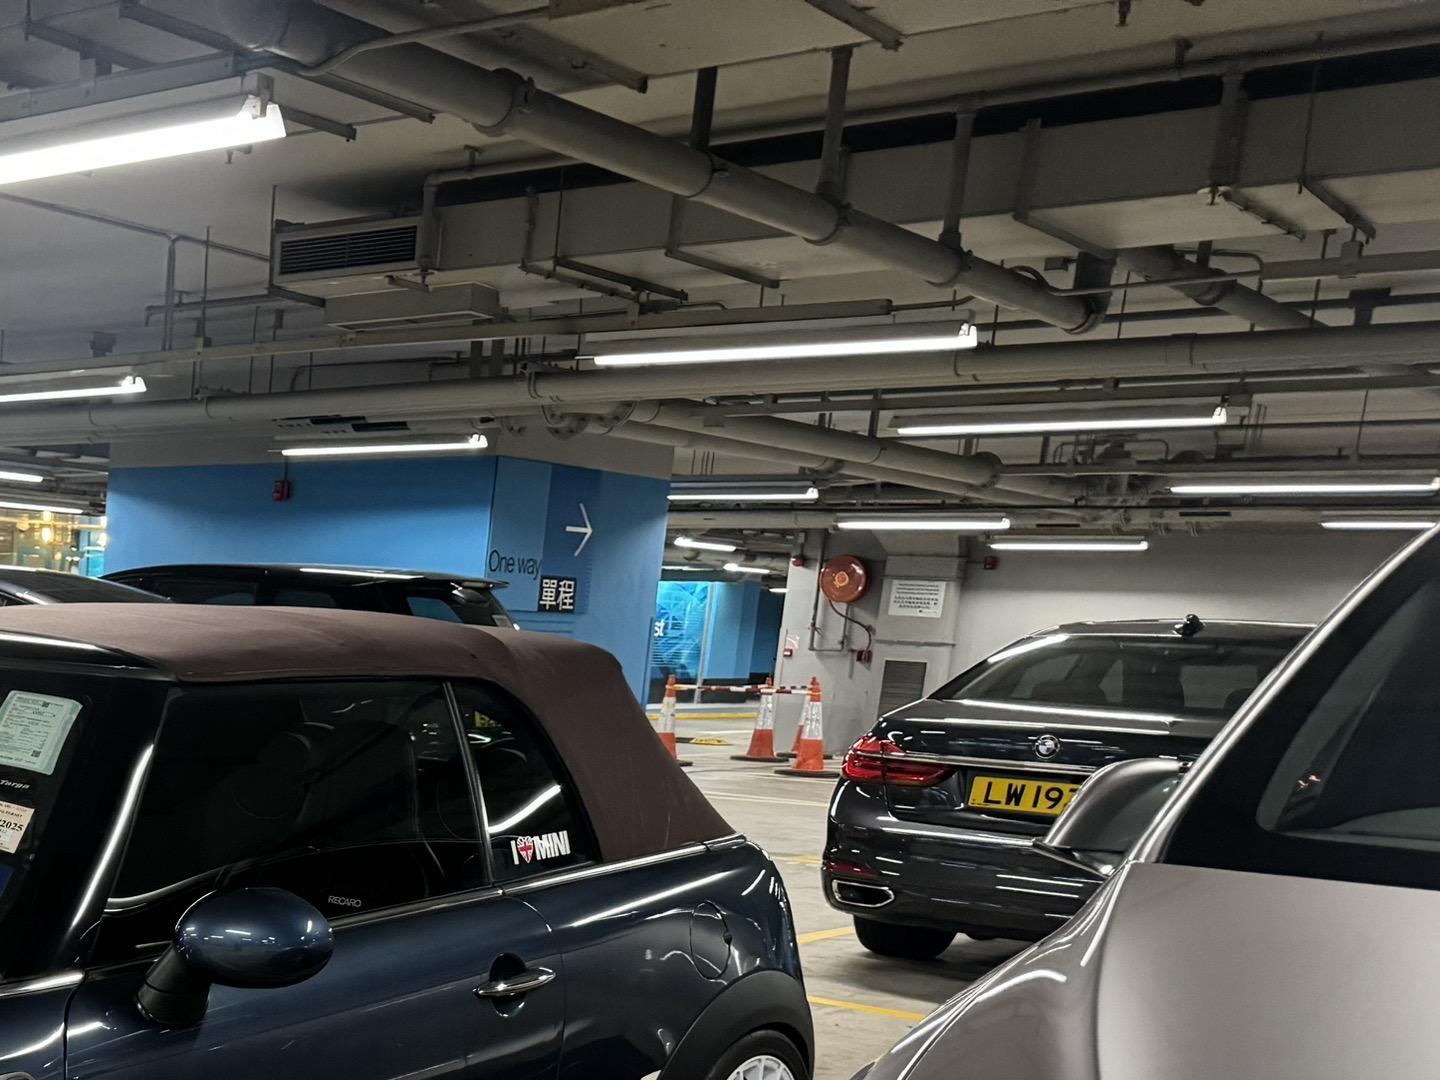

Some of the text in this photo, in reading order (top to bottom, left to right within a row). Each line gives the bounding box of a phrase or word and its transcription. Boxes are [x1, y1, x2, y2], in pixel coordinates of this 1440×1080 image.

[488, 549, 542, 580] One way
[539, 578, 576, 611] 單程
[983, 781, 1078, 810] LW 19
[533, 830, 571, 861] MINI
[327, 895, 362, 908] RECARO
